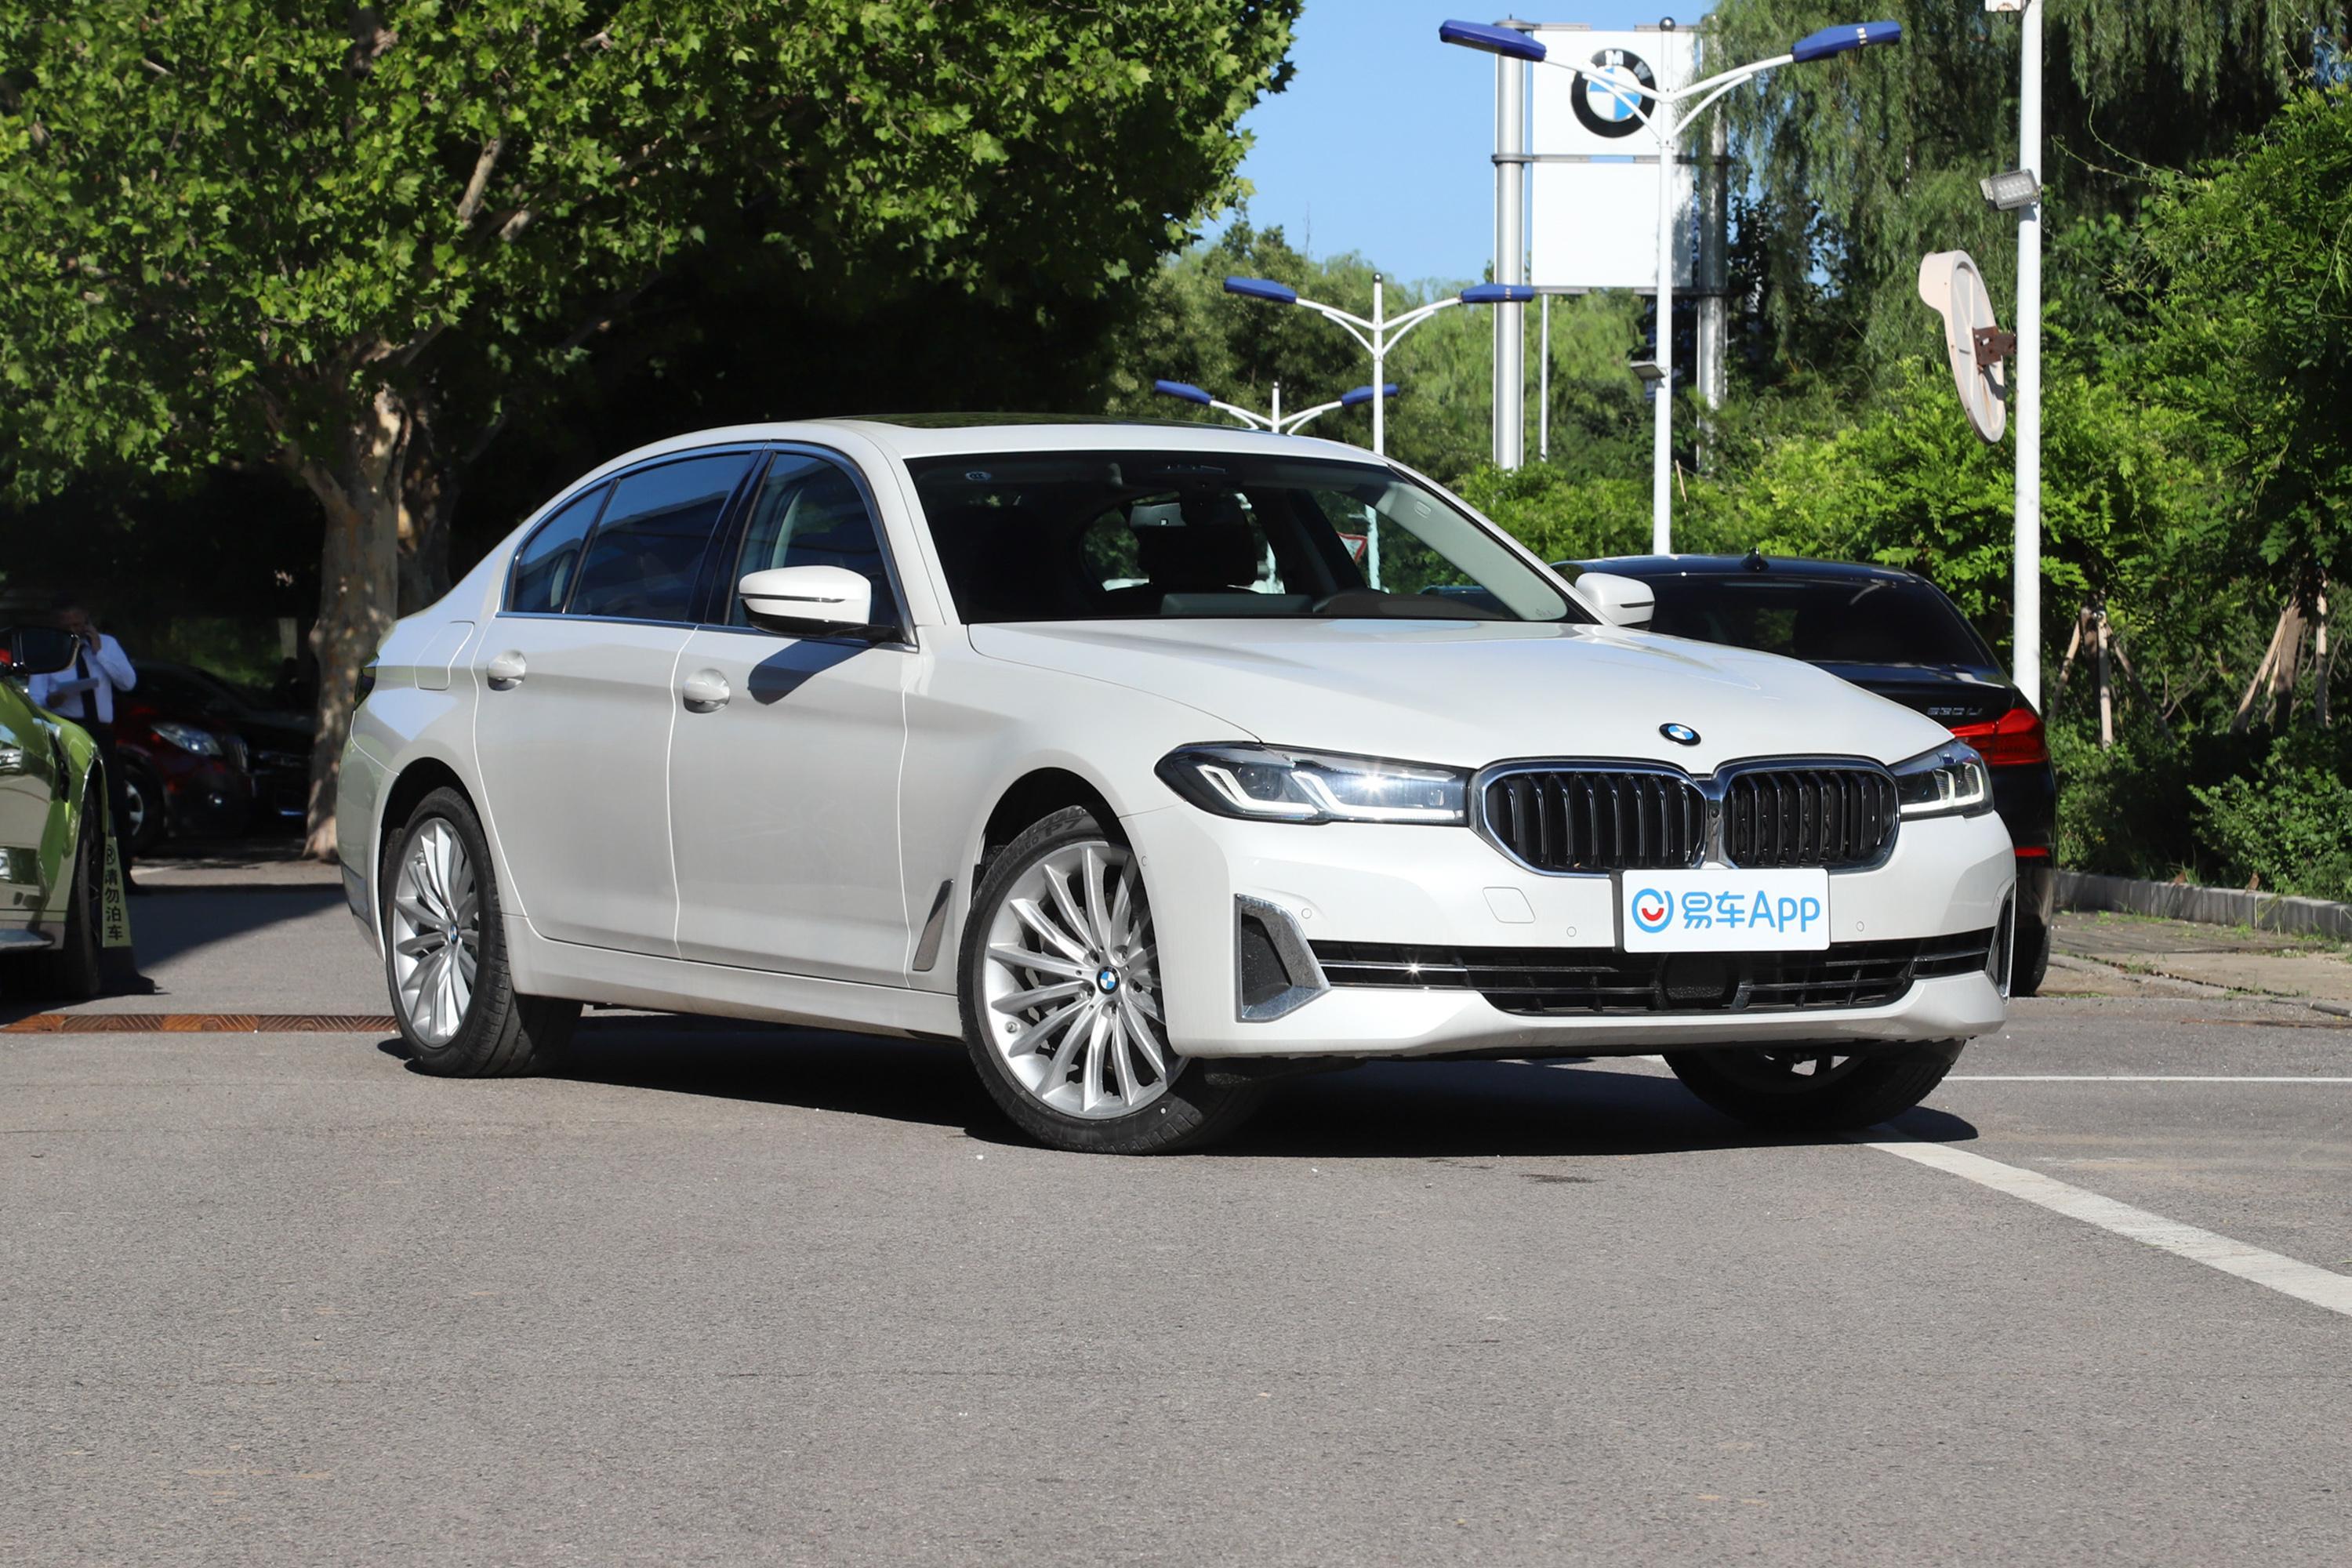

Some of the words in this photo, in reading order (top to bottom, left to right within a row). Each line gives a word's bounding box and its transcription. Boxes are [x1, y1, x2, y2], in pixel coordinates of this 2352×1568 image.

[105, 869, 123, 940] 请勿泊车
[1682, 891, 1744, 928] 易车
[1748, 890, 1820, 932] App
